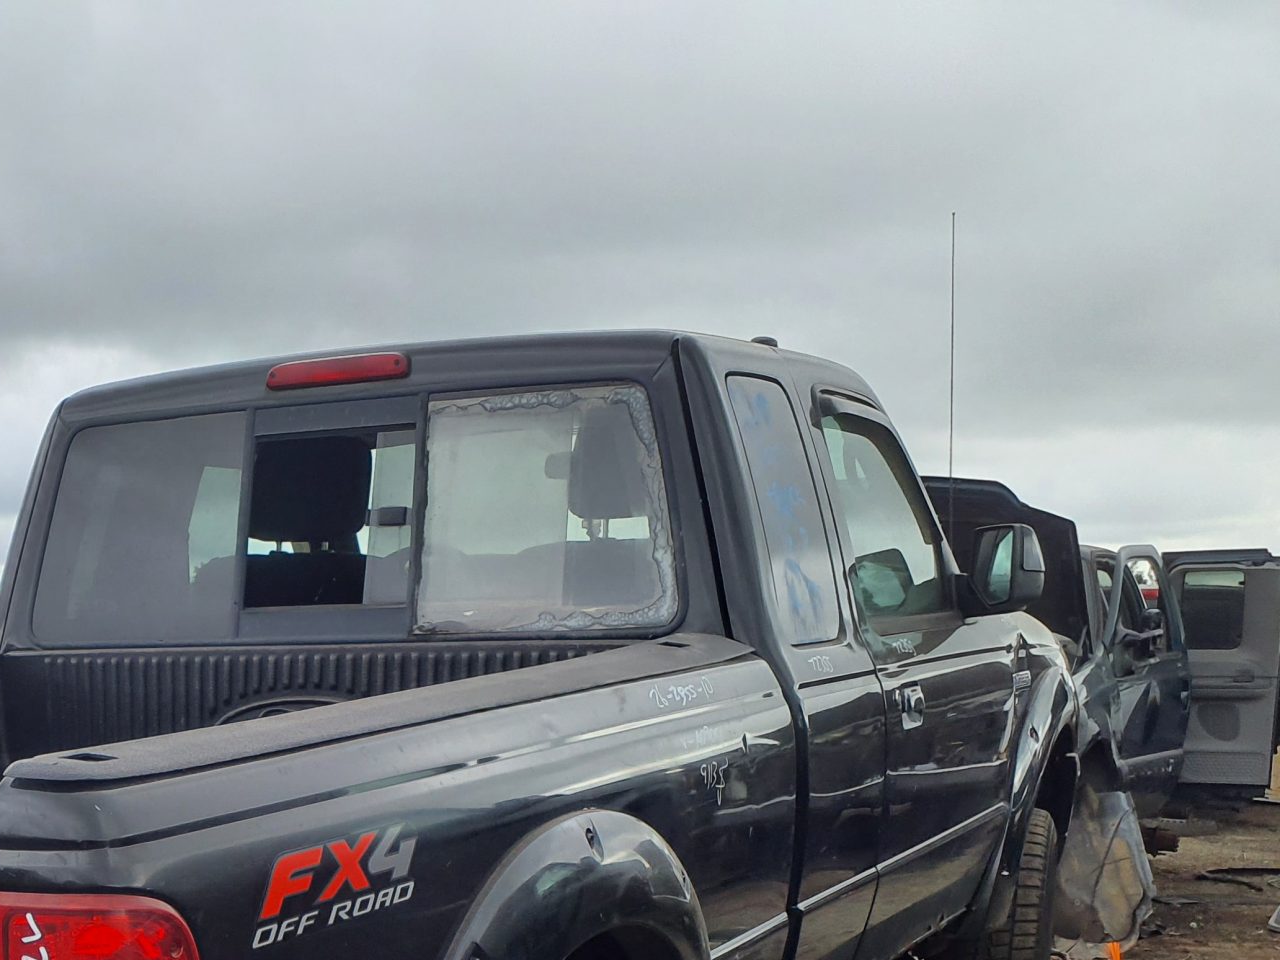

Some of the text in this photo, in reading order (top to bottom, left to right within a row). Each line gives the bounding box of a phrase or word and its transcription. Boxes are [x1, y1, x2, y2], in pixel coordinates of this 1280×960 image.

[260, 822, 418, 921] FX4
[252, 880, 416, 949] OFF ROAD
